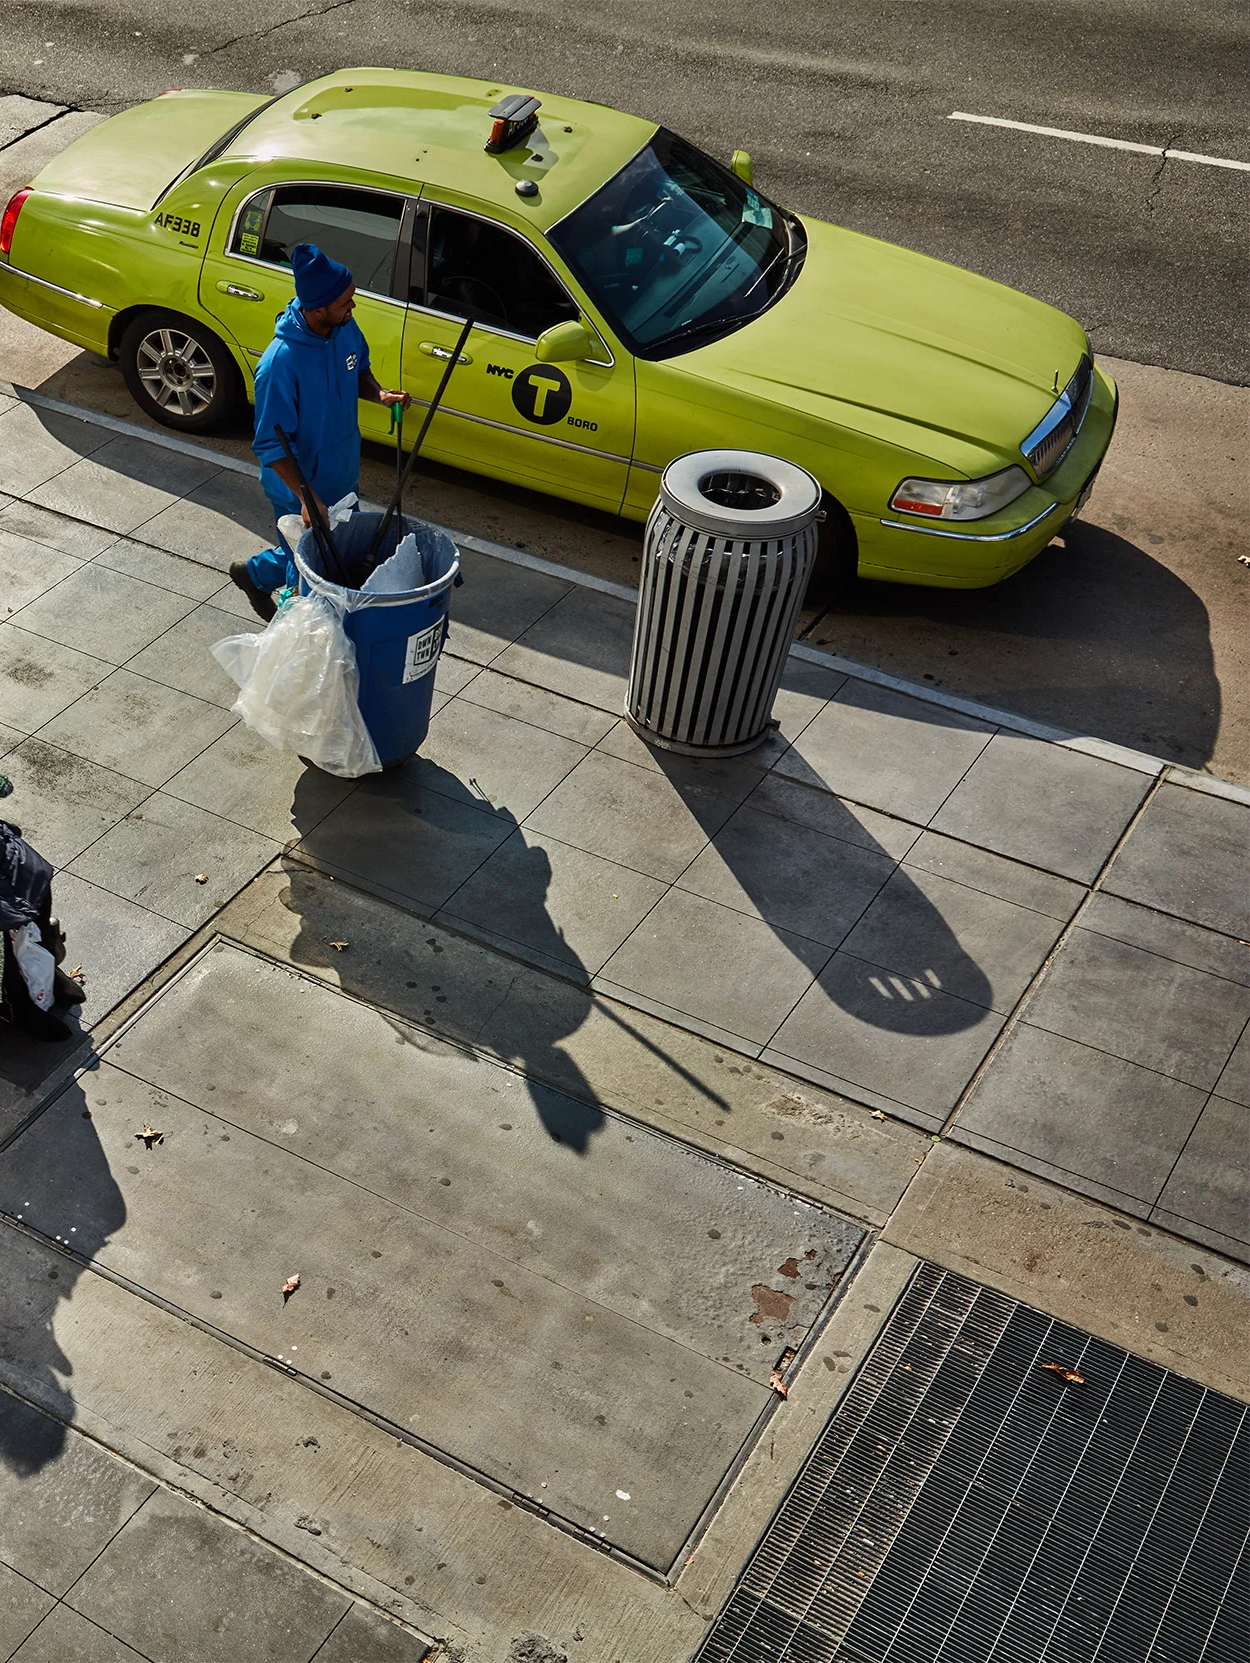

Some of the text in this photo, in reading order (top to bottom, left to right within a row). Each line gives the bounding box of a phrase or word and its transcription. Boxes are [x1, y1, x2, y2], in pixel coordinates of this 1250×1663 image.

[154, 212, 201, 237] AF338
[486, 364, 514, 379] NYC
[528, 375, 561, 417] T
[567, 416, 598, 432] BORO
